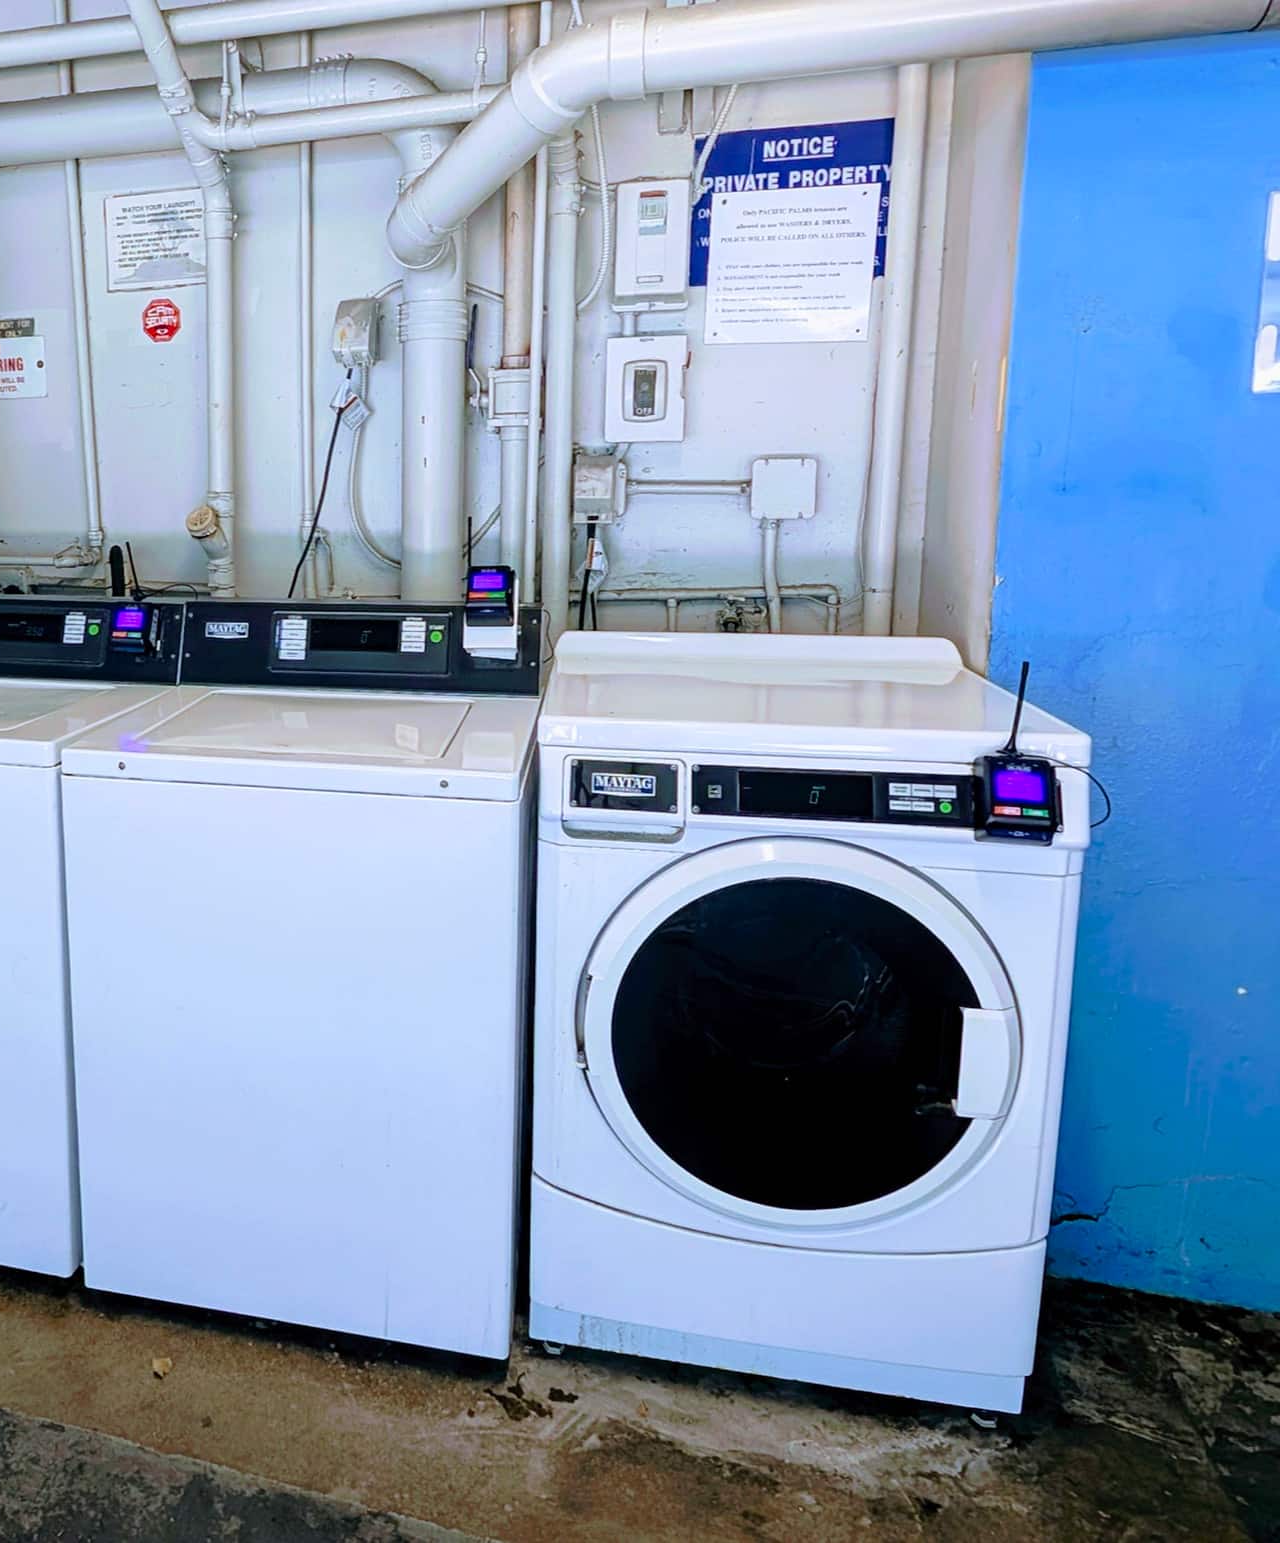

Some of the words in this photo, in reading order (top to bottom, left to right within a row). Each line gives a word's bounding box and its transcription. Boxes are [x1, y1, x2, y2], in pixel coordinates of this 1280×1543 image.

[762, 135, 835, 158] NOTICE
[703, 172, 780, 193] PRIVATE
[788, 164, 892, 188] PROPERTY
[758, 208, 787, 216] PACIFIC
[778, 233, 807, 241] CALLED
[208, 623, 247, 633] MAYTAG
[595, 775, 652, 789] MAYTAG
